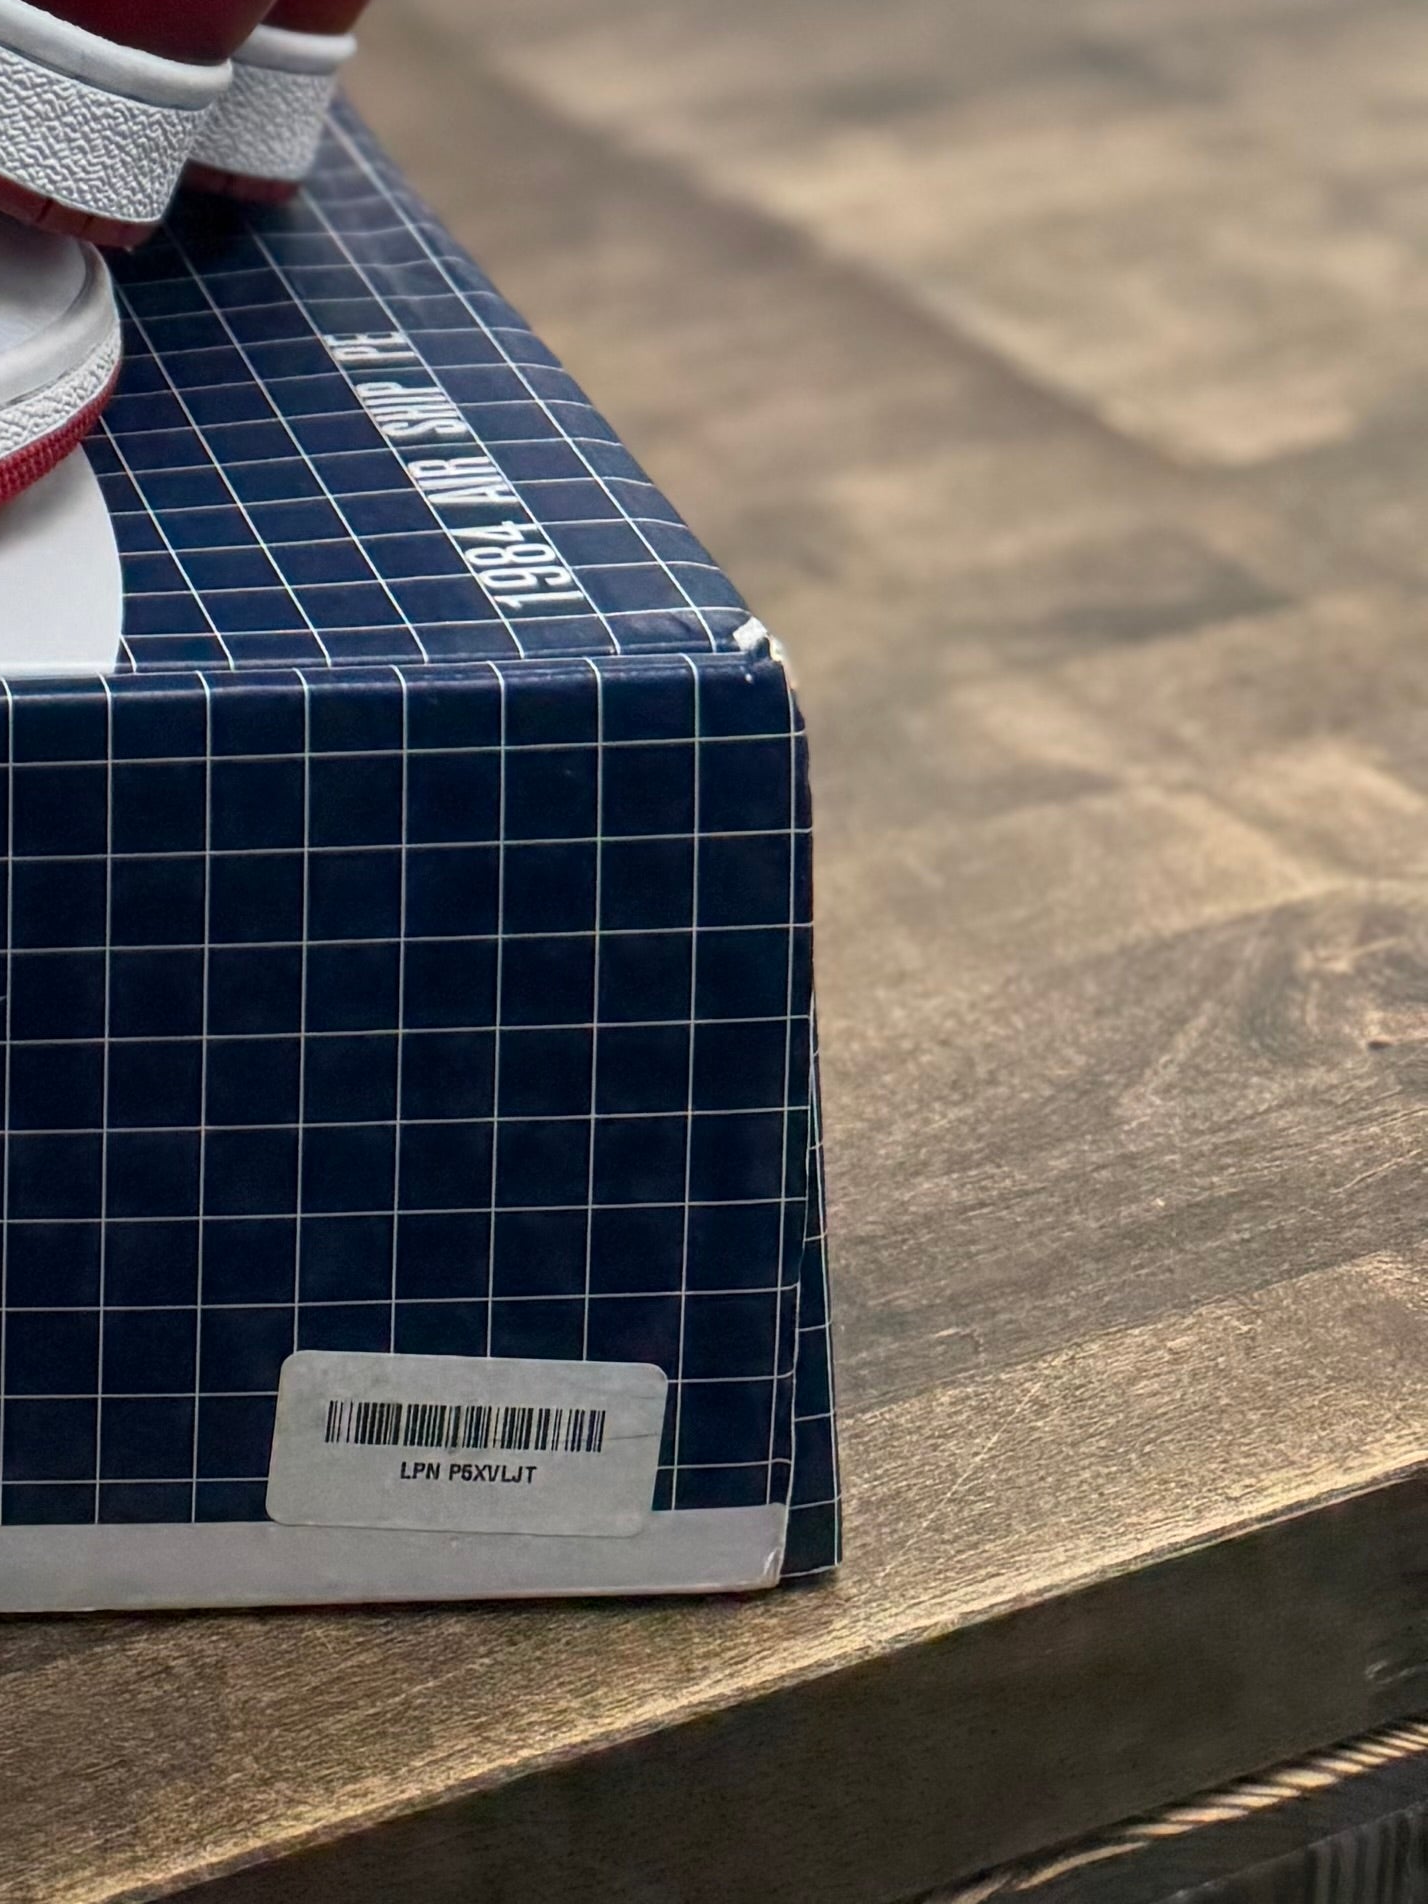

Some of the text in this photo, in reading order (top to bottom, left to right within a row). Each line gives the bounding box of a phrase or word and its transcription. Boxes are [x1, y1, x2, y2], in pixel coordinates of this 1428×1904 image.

[324, 332, 584, 608] 1984 AIR SHIP PE
[400, 1461, 441, 1481] LPN
